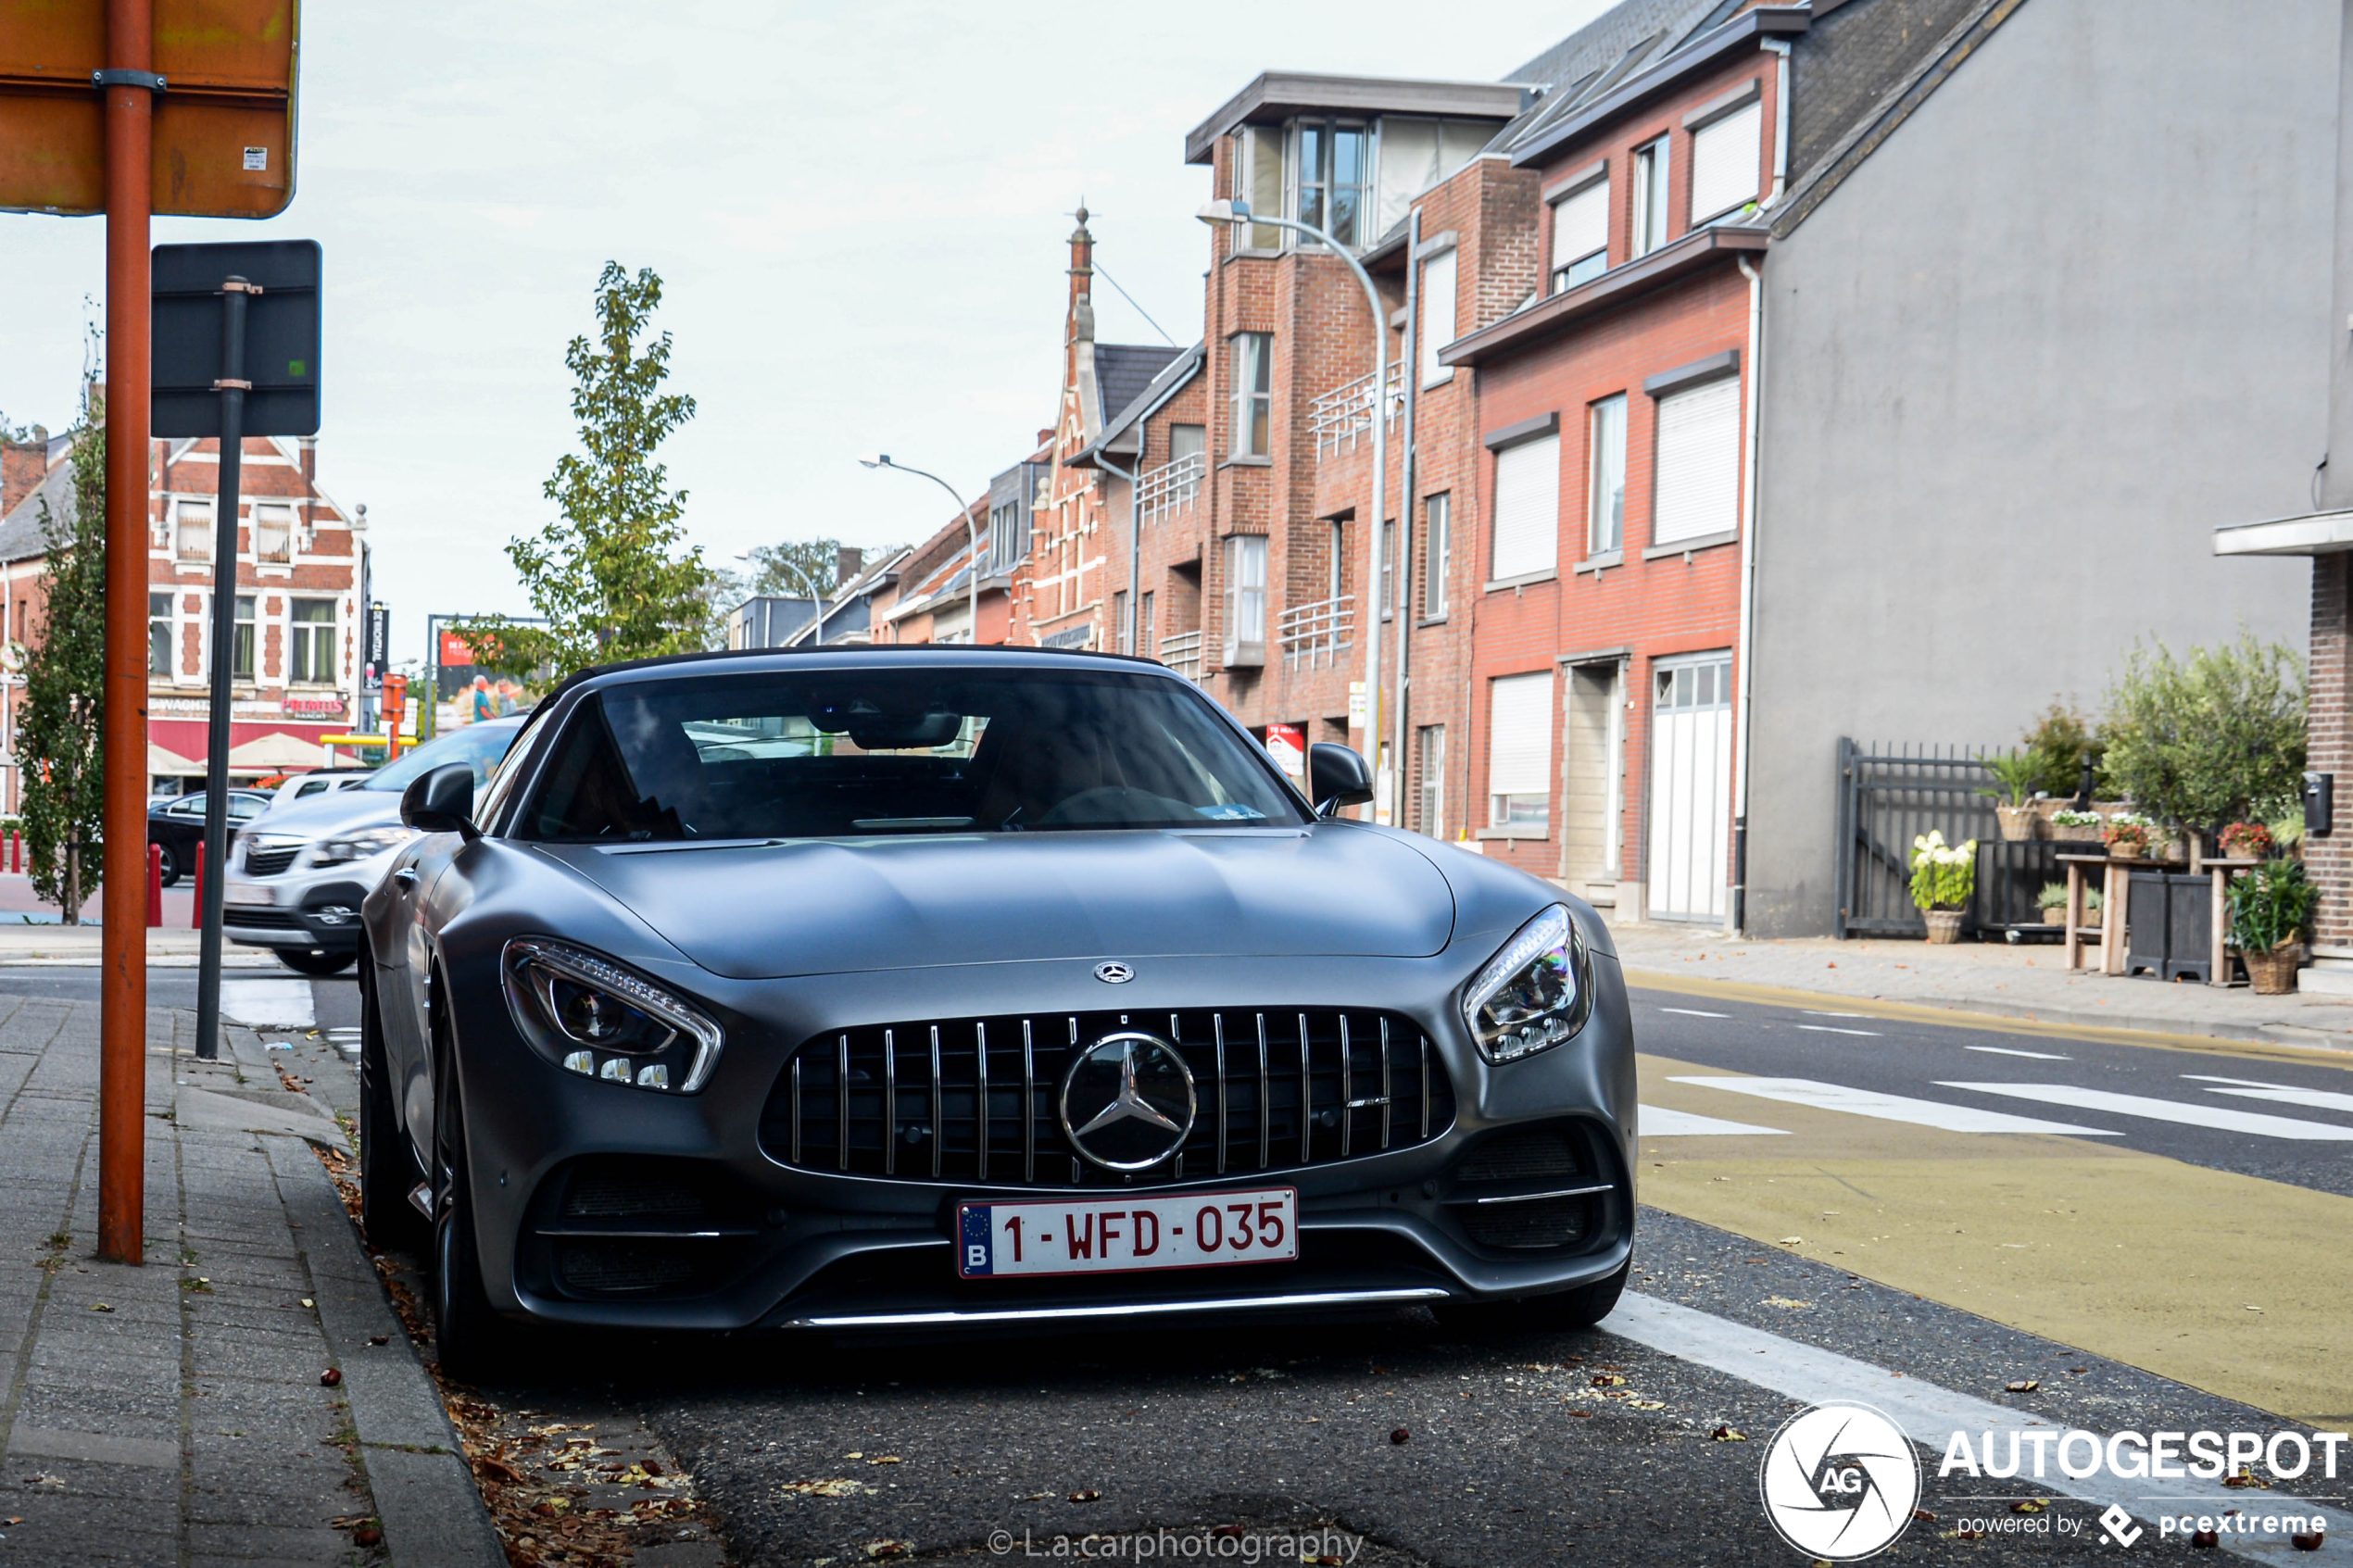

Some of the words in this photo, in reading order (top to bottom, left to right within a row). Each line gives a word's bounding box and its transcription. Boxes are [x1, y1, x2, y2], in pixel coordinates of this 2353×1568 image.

[281, 698, 344, 713] PRIMUS
[1004, 1201, 1284, 1262] 1-WFD-035
[967, 1245, 988, 1267] B
